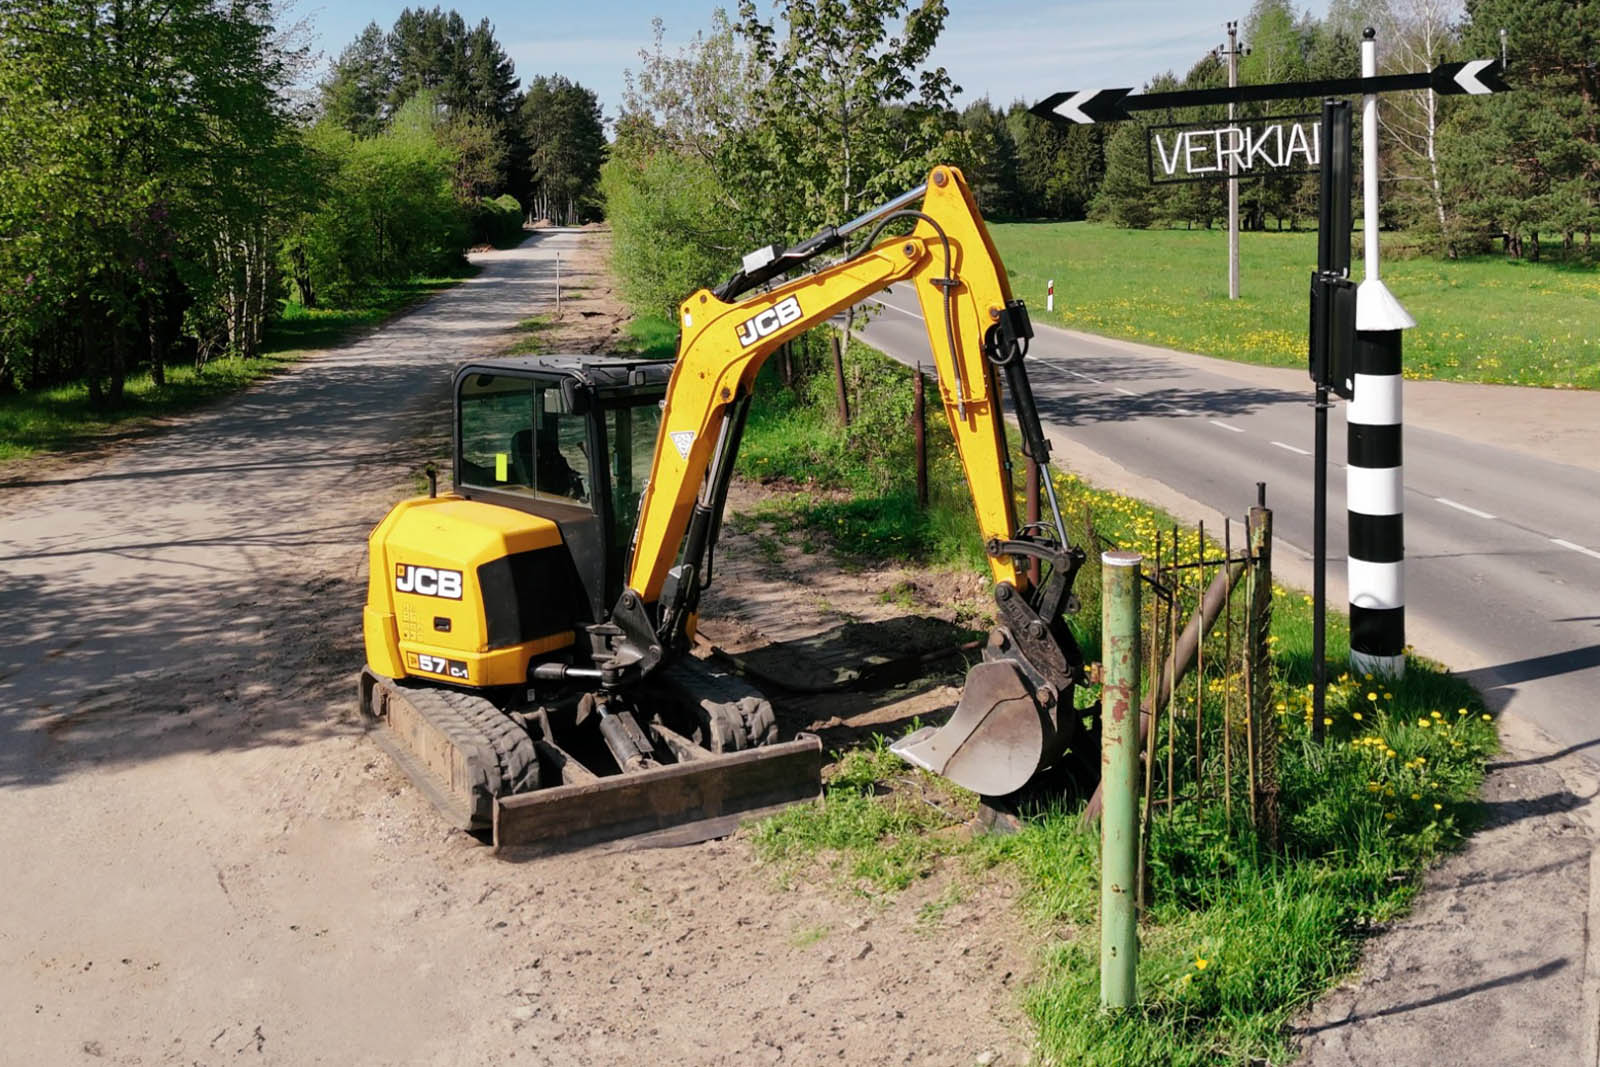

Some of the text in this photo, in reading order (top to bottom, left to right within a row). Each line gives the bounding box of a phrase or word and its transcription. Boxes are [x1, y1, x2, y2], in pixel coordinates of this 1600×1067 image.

[1155, 121, 1321, 174] VERKIAI
[740, 296, 802, 346] JCB
[396, 565, 462, 599] JCB
[419, 654, 446, 673] 57
